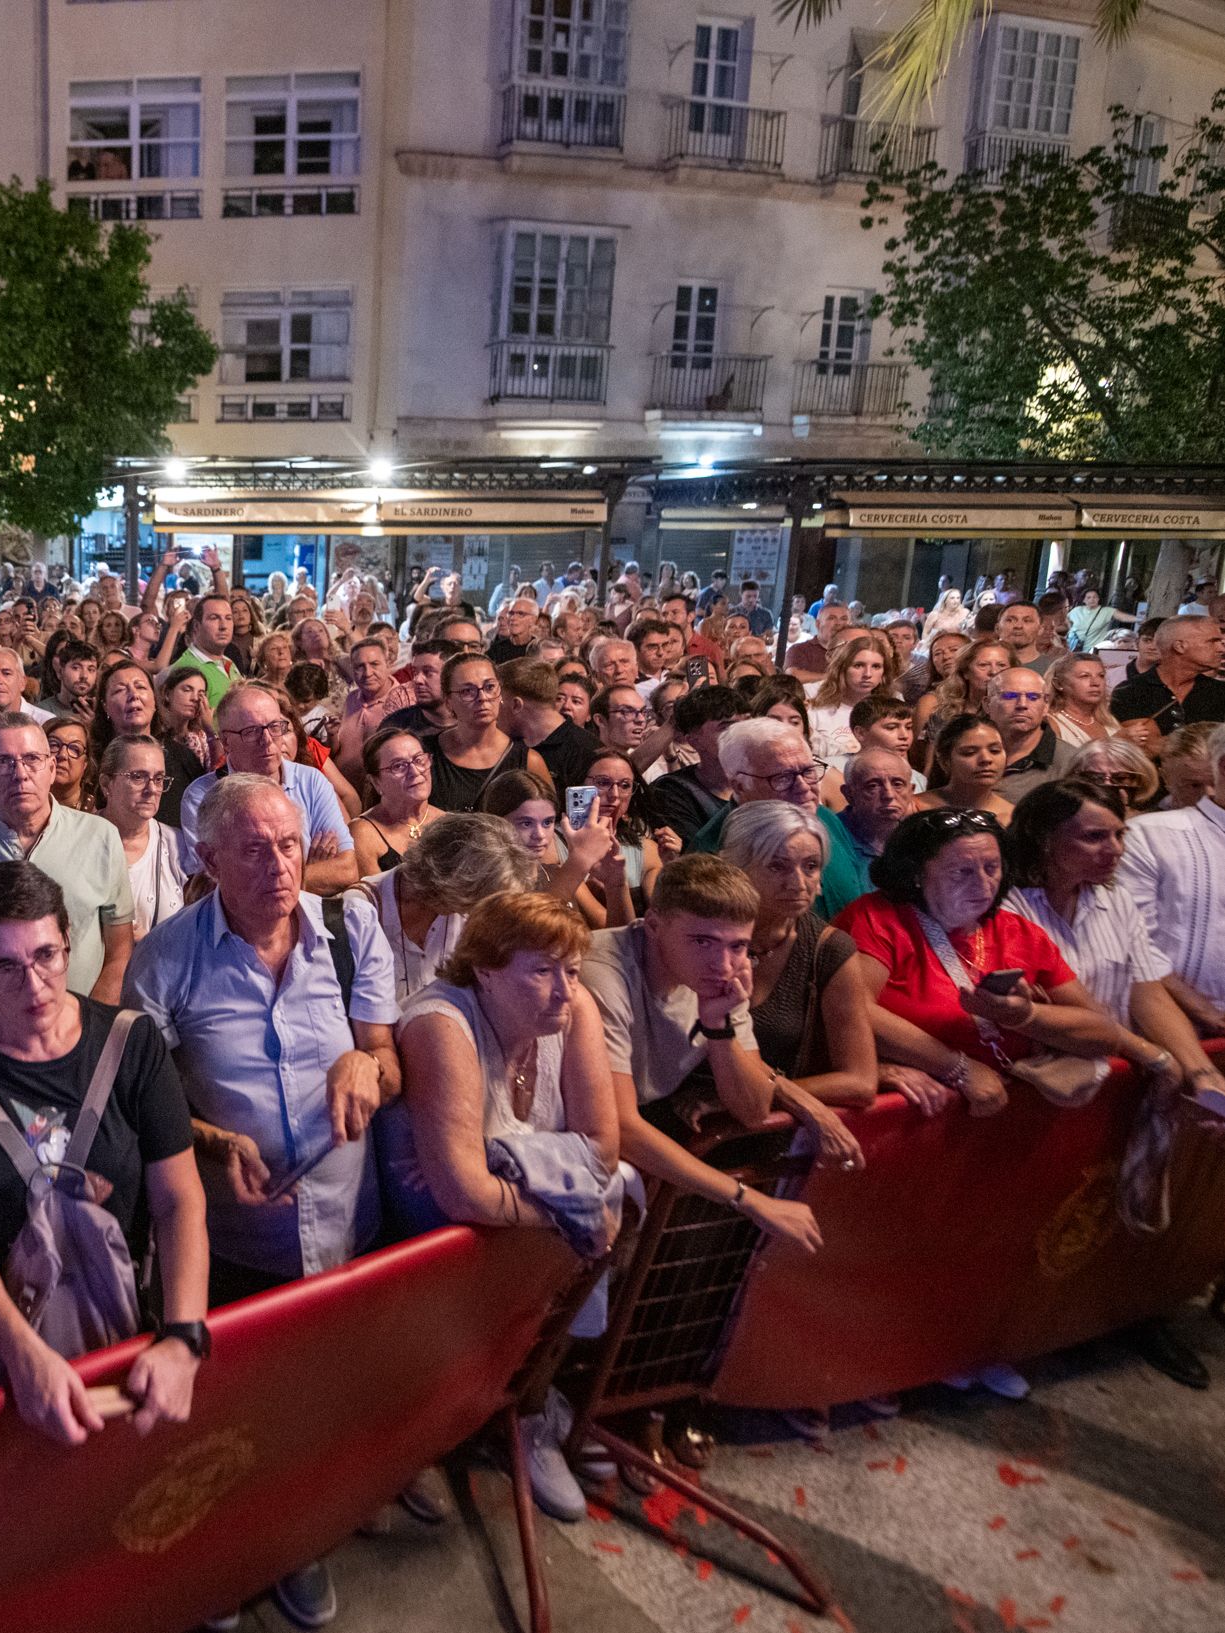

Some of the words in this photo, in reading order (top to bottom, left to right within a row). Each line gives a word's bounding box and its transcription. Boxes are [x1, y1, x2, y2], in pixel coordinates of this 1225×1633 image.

[183, 507, 244, 517] SARDINERO
[394, 507, 407, 516] EL
[410, 508, 473, 517] SARDINERO
[859, 513, 928, 524] CERVECERÍA
[931, 514, 968, 524] COSTA
[1092, 513, 1160, 524] CERVECERÍA
[1163, 515, 1200, 525] COSTA
